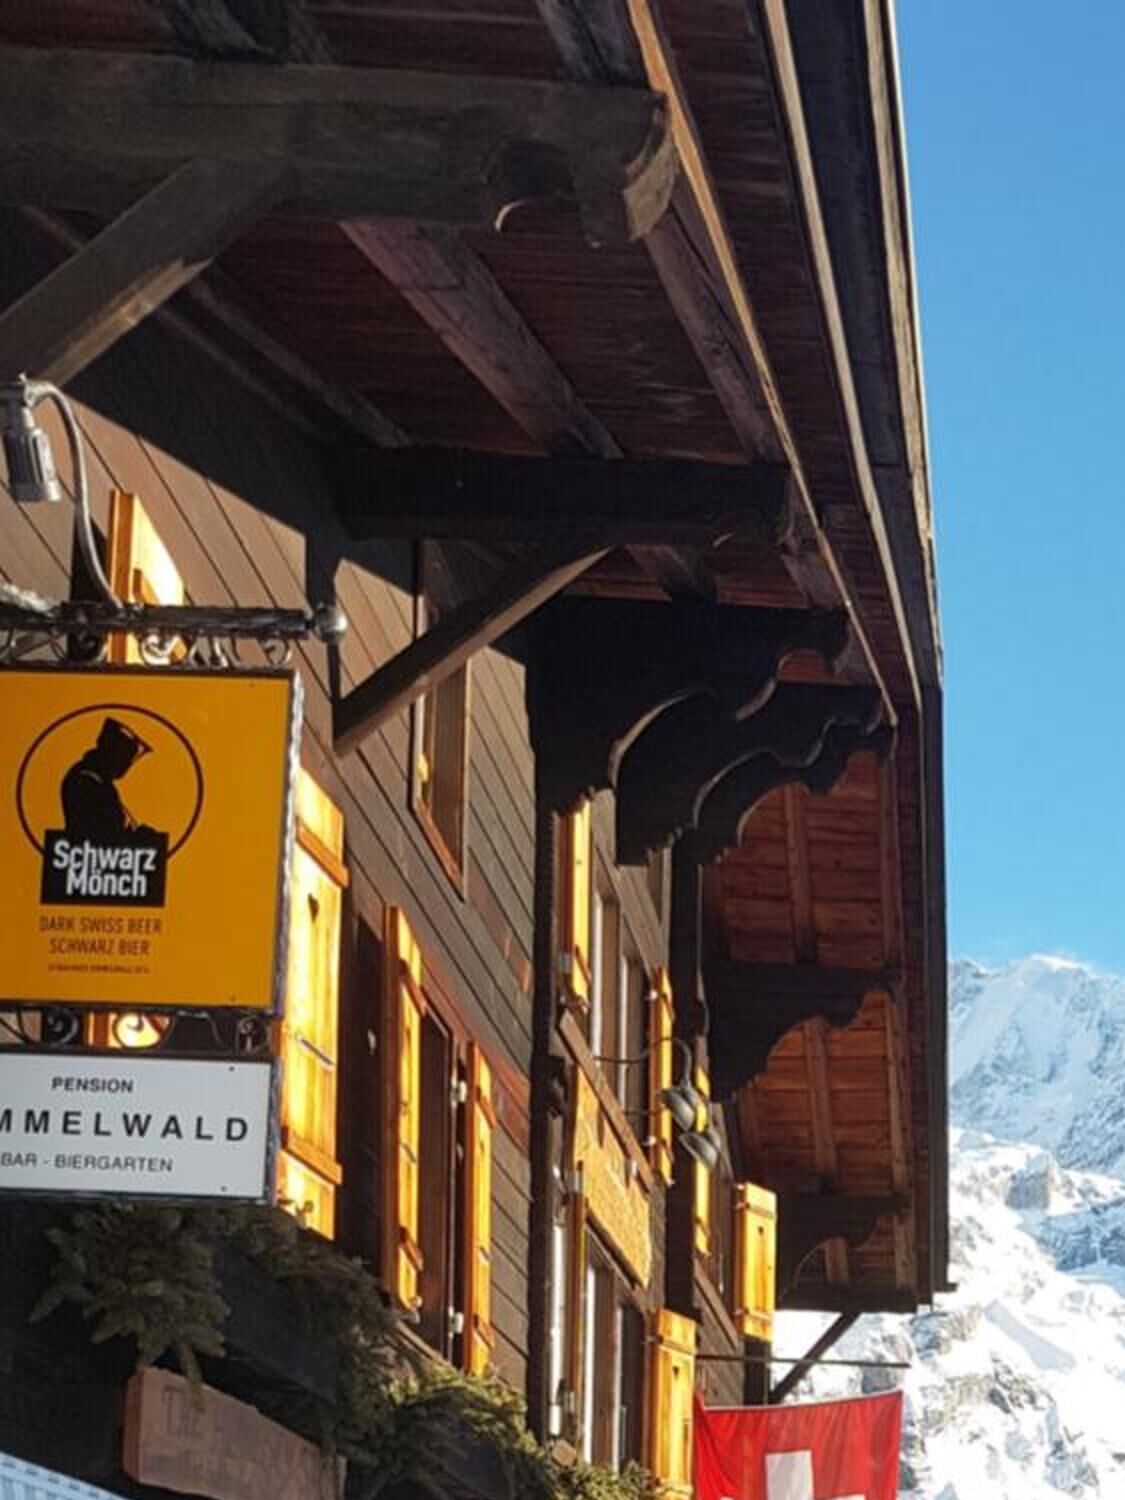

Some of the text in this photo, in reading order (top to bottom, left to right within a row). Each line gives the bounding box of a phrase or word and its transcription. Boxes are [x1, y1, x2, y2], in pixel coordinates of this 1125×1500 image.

[53, 839, 157, 871] Schwarz
[66, 866, 147, 897] Mönch
[40, 915, 162, 935] DARK SWISS BEER
[49, 937, 150, 956] SCHWARZ BIER
[51, 1076, 134, 1094] PENSION
[0, 1151, 38, 1168] BAR
[54, 1153, 174, 1173] BIERGARTEN
